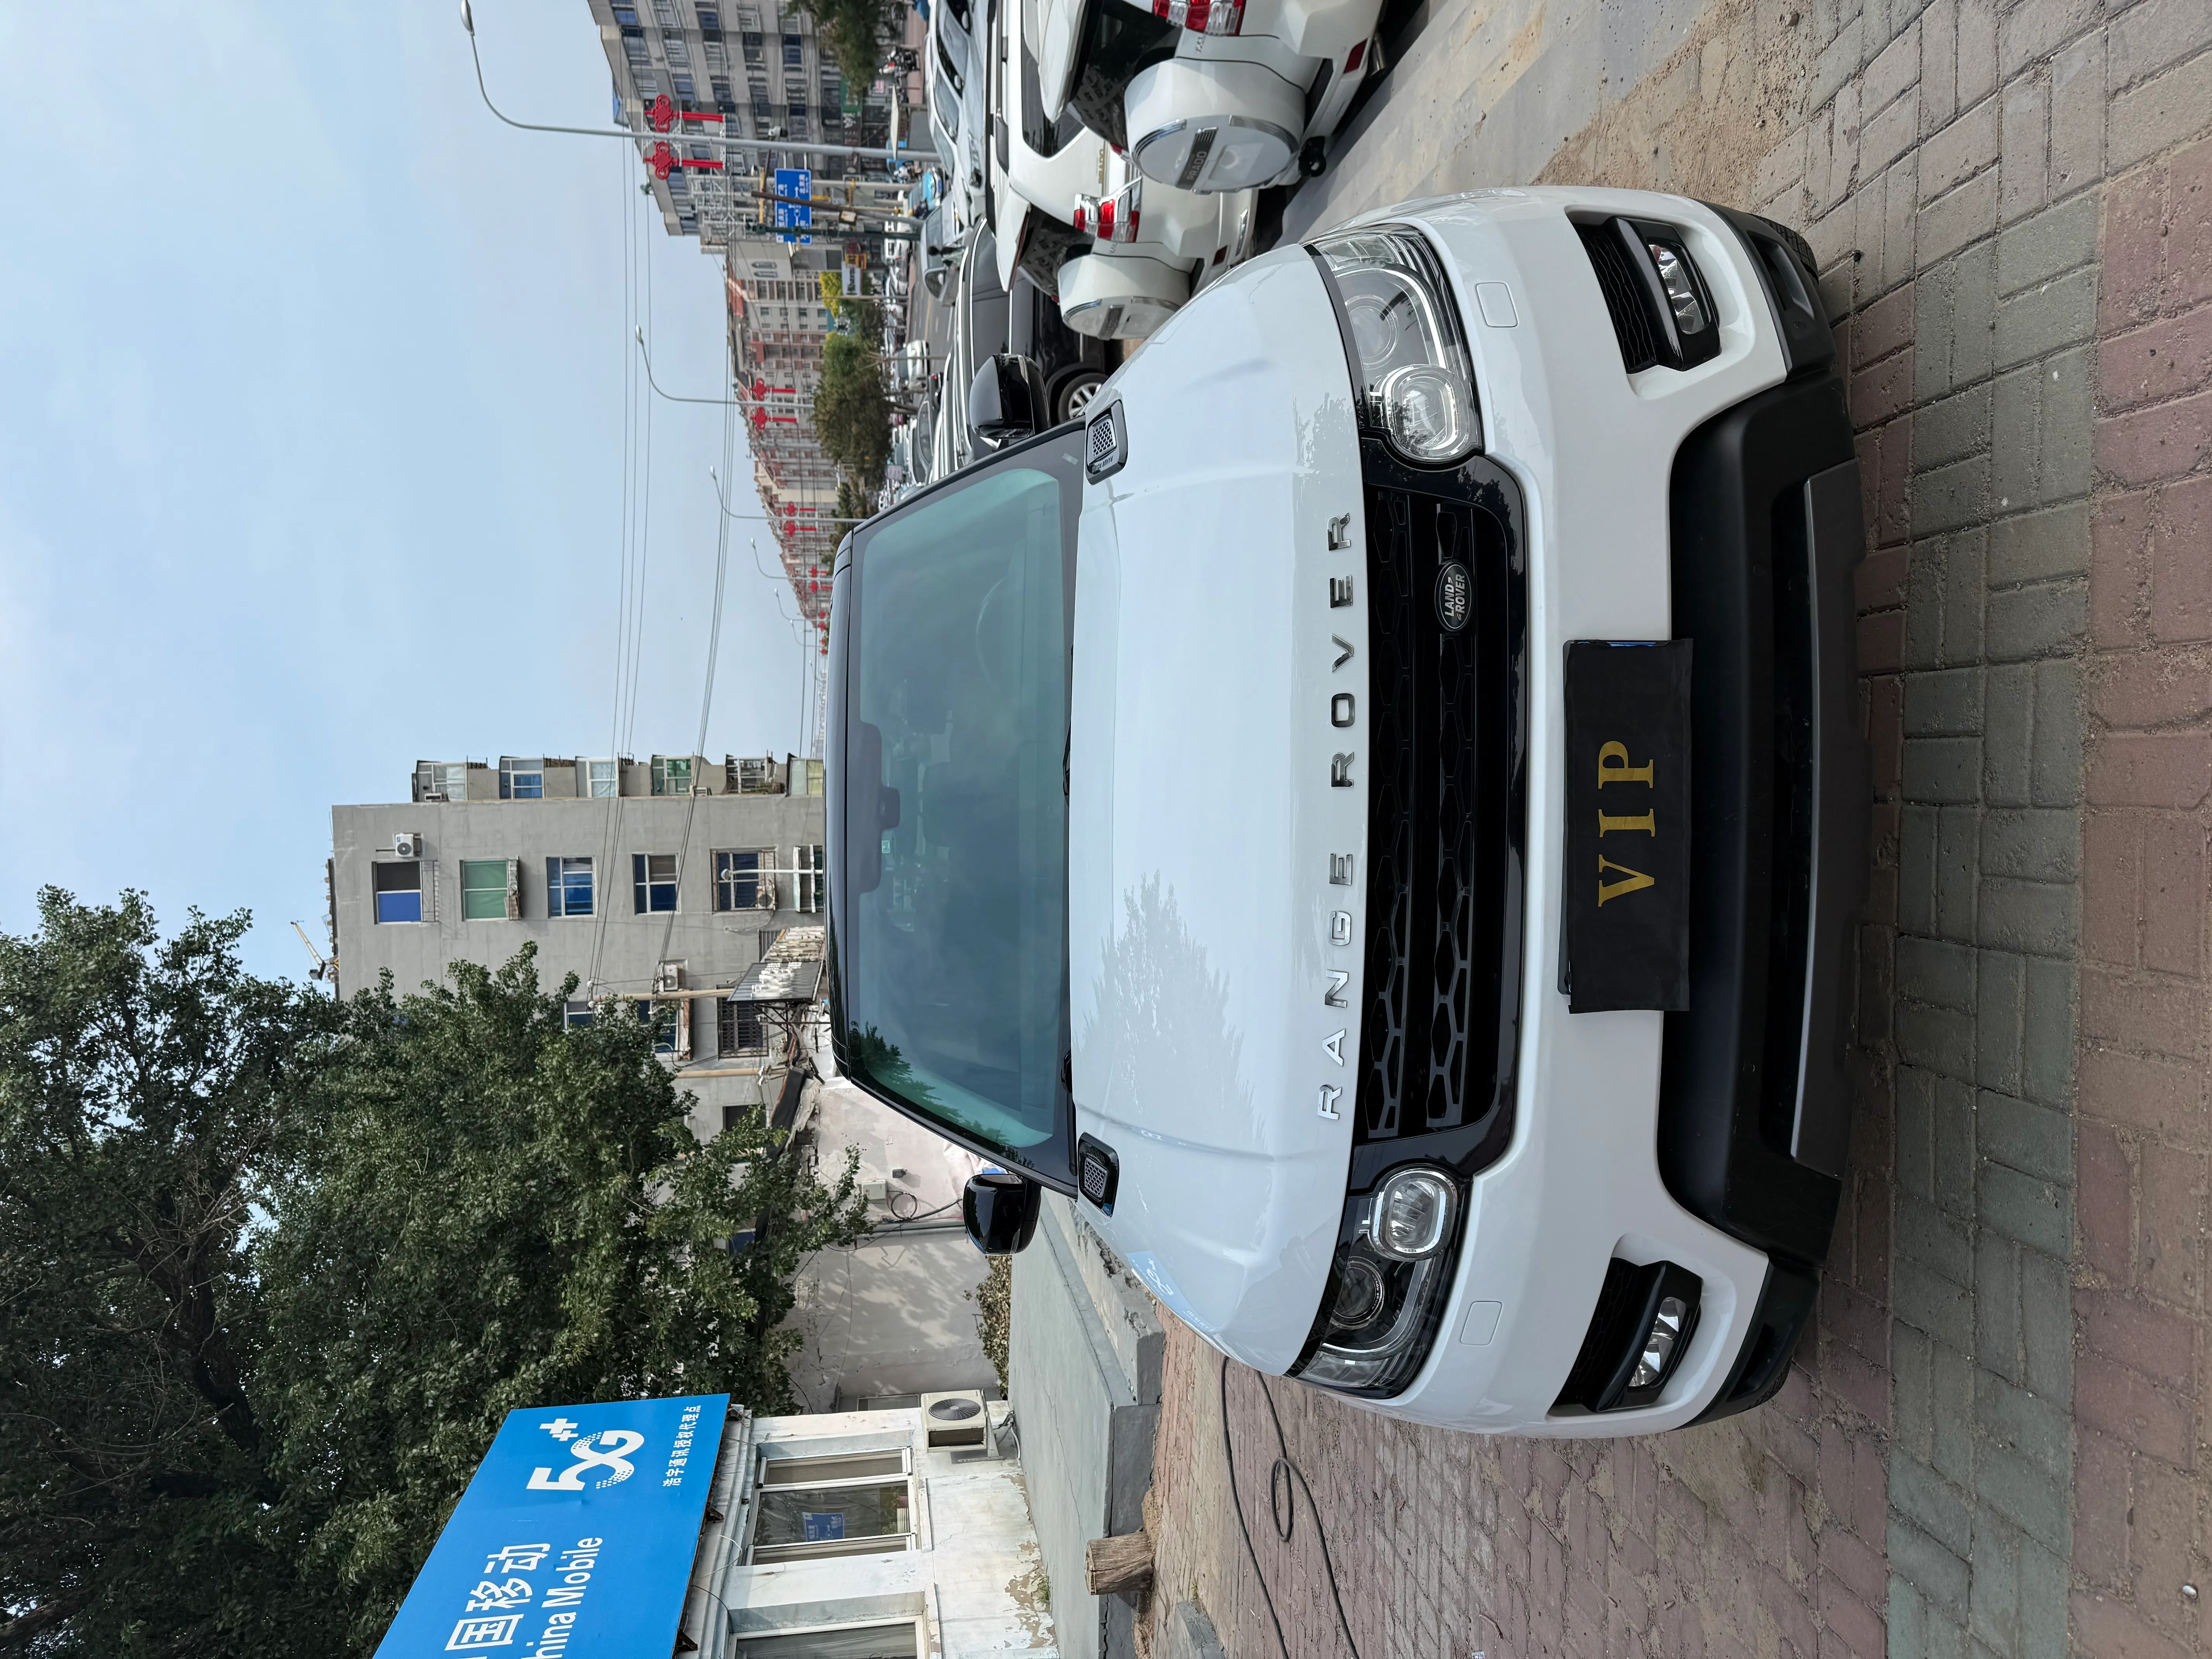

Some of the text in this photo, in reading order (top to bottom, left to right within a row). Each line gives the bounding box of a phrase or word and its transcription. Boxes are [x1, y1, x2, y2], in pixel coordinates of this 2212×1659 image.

[1187, 151, 1207, 180] PRADO
[1444, 584, 1454, 617] LAND
[1455, 574, 1465, 613] ROVER
[1317, 512, 1354, 1120] RANGE ROVER
[1597, 740, 1655, 907] VIP
[662, 1405, 701, 1486] 浩宇通讯授权代理点
[445, 1543, 550, 1659] 国移动
[541, 1537, 603, 1607] Mobile
